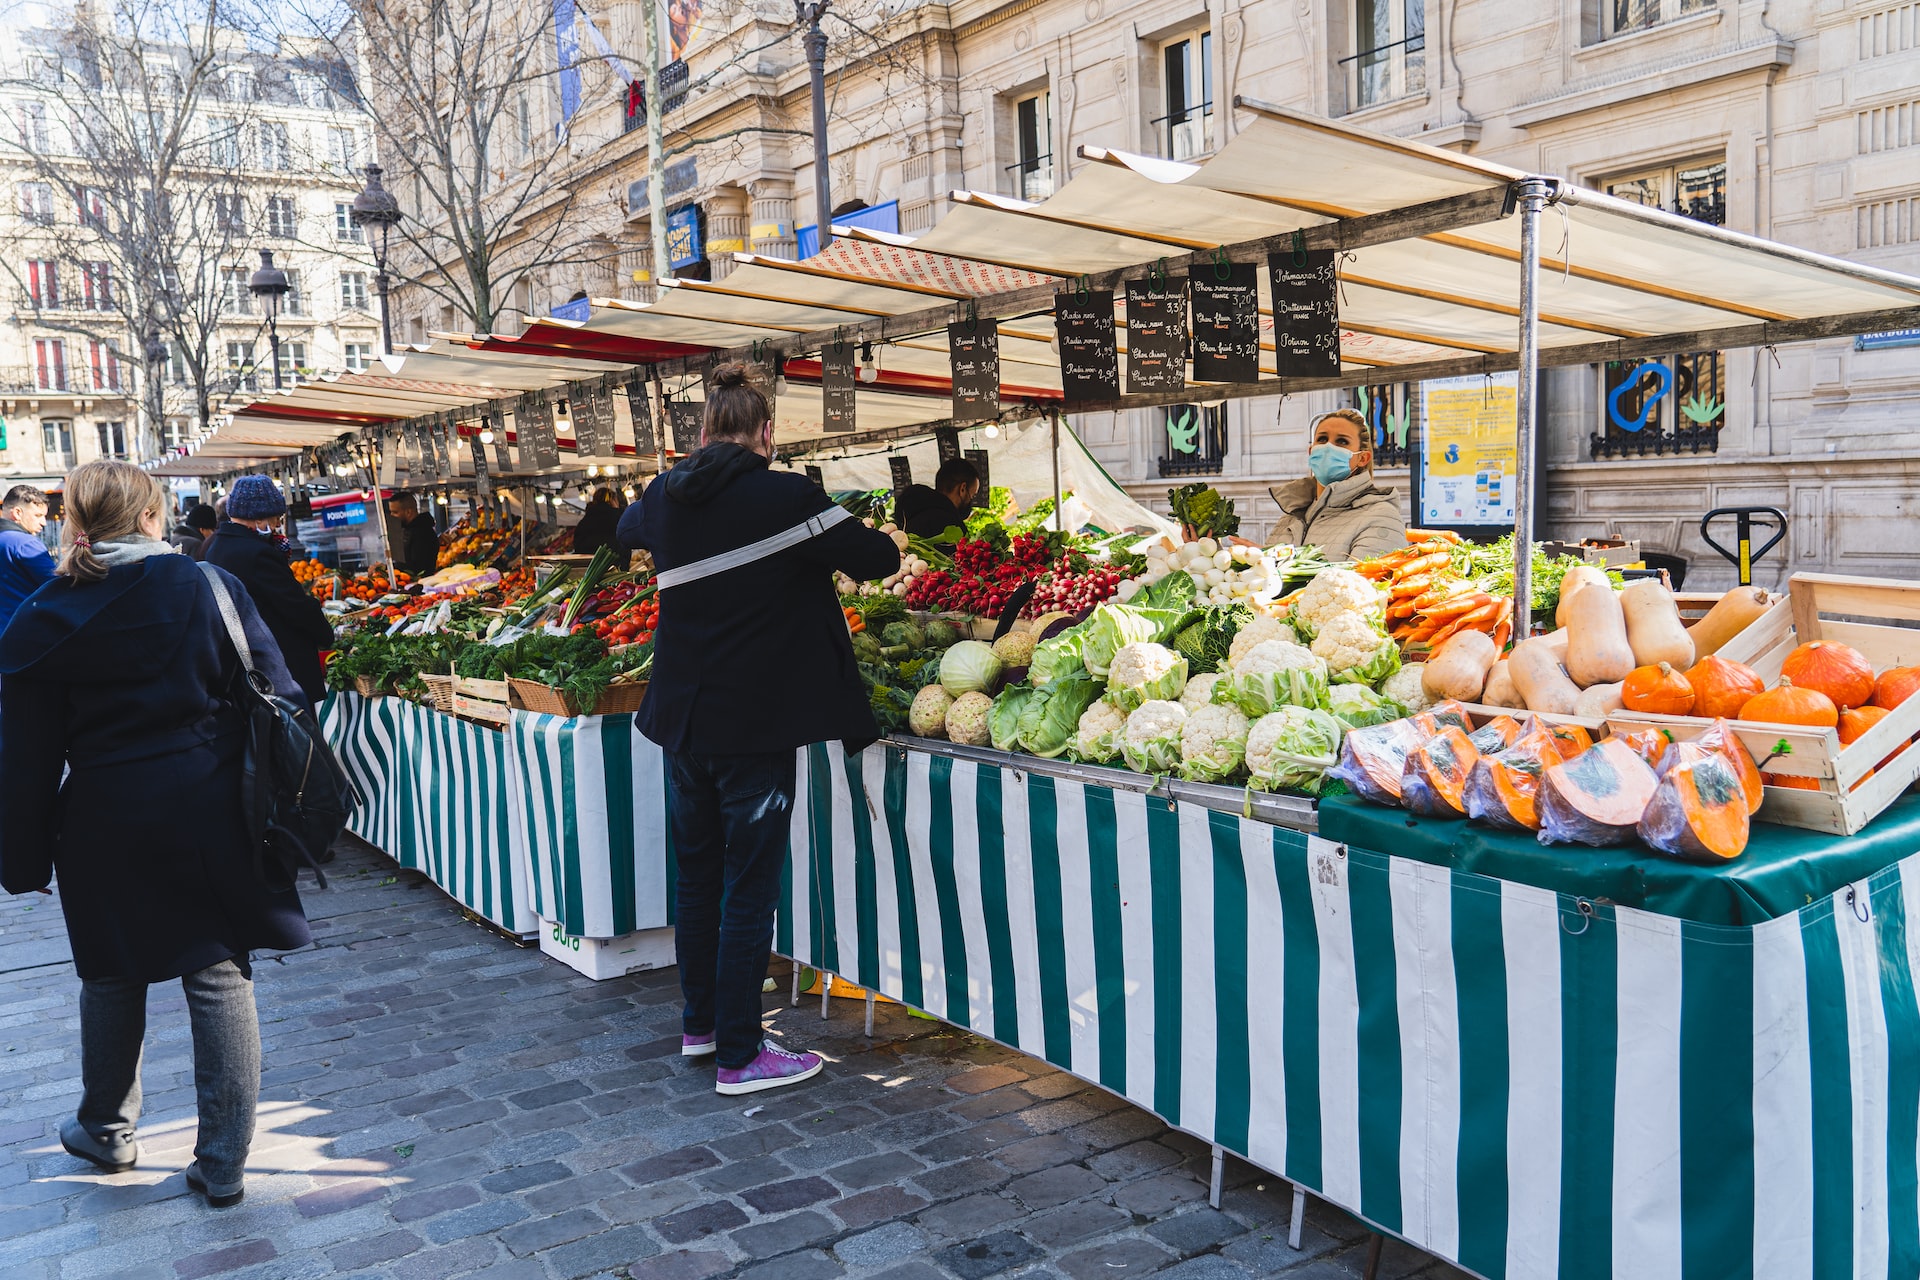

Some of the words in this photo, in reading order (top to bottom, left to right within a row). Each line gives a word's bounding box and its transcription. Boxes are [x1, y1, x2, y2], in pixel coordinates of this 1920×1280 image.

[1194, 281, 1213, 292] Chou
[1130, 290, 1146, 302] Chou
[1278, 299, 1315, 313] Butternut
[1061, 309, 1081, 320] Radis
[1196, 313, 1213, 323] Chou
[1214, 312, 1232, 324] fleur
[1063, 336, 1082, 346] Radis
[1281, 332, 1309, 348] Potiron
[1199, 341, 1216, 352] Chou
[1132, 348, 1147, 359] Chou
[1066, 363, 1084, 375] Radis
